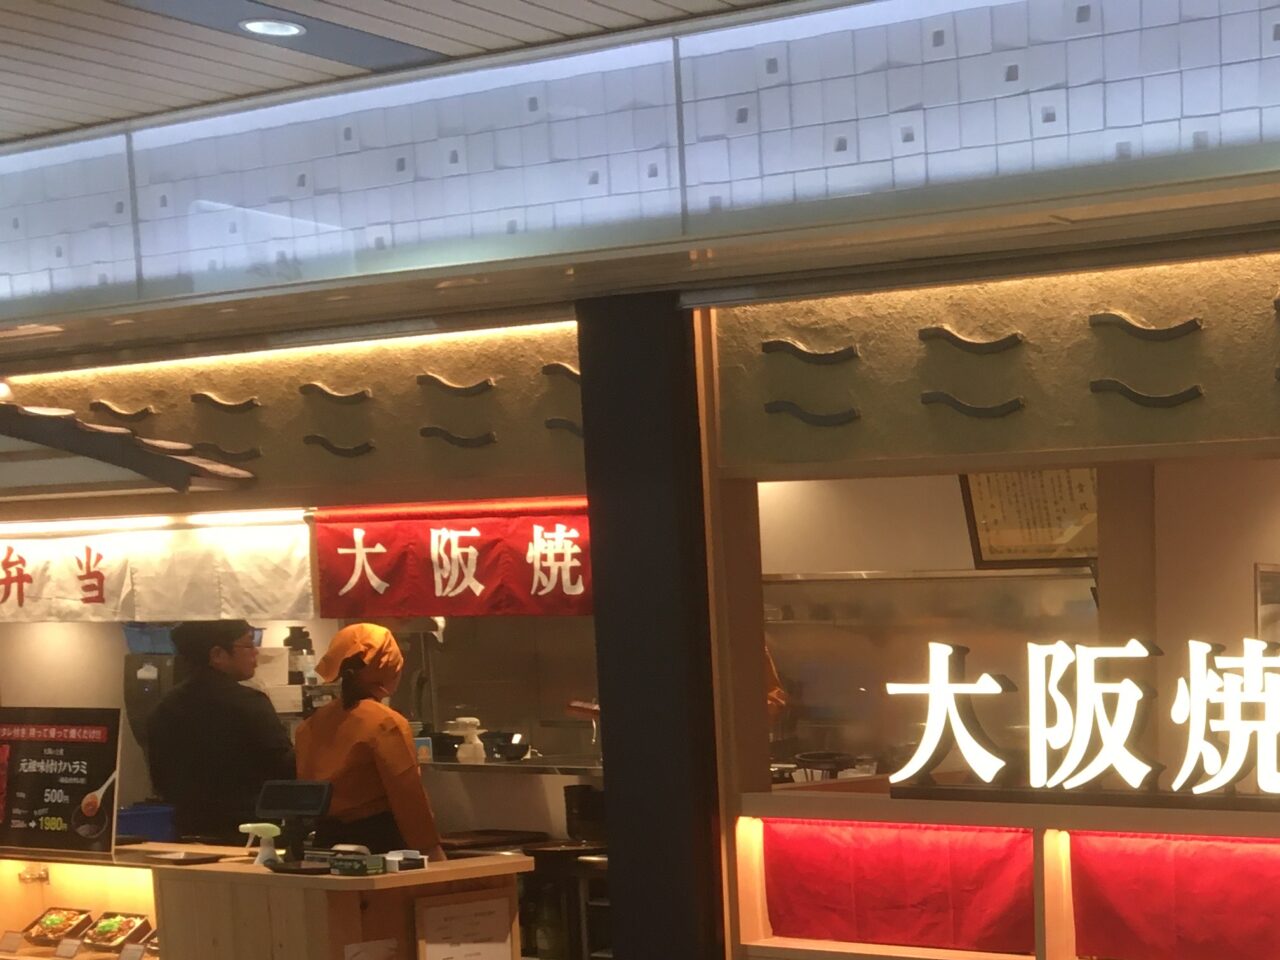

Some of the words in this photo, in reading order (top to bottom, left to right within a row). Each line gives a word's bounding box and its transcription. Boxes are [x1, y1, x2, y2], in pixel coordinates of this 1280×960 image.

[0, 545, 106, 608] 弁当
[337, 523, 585, 599] 大阪焼
